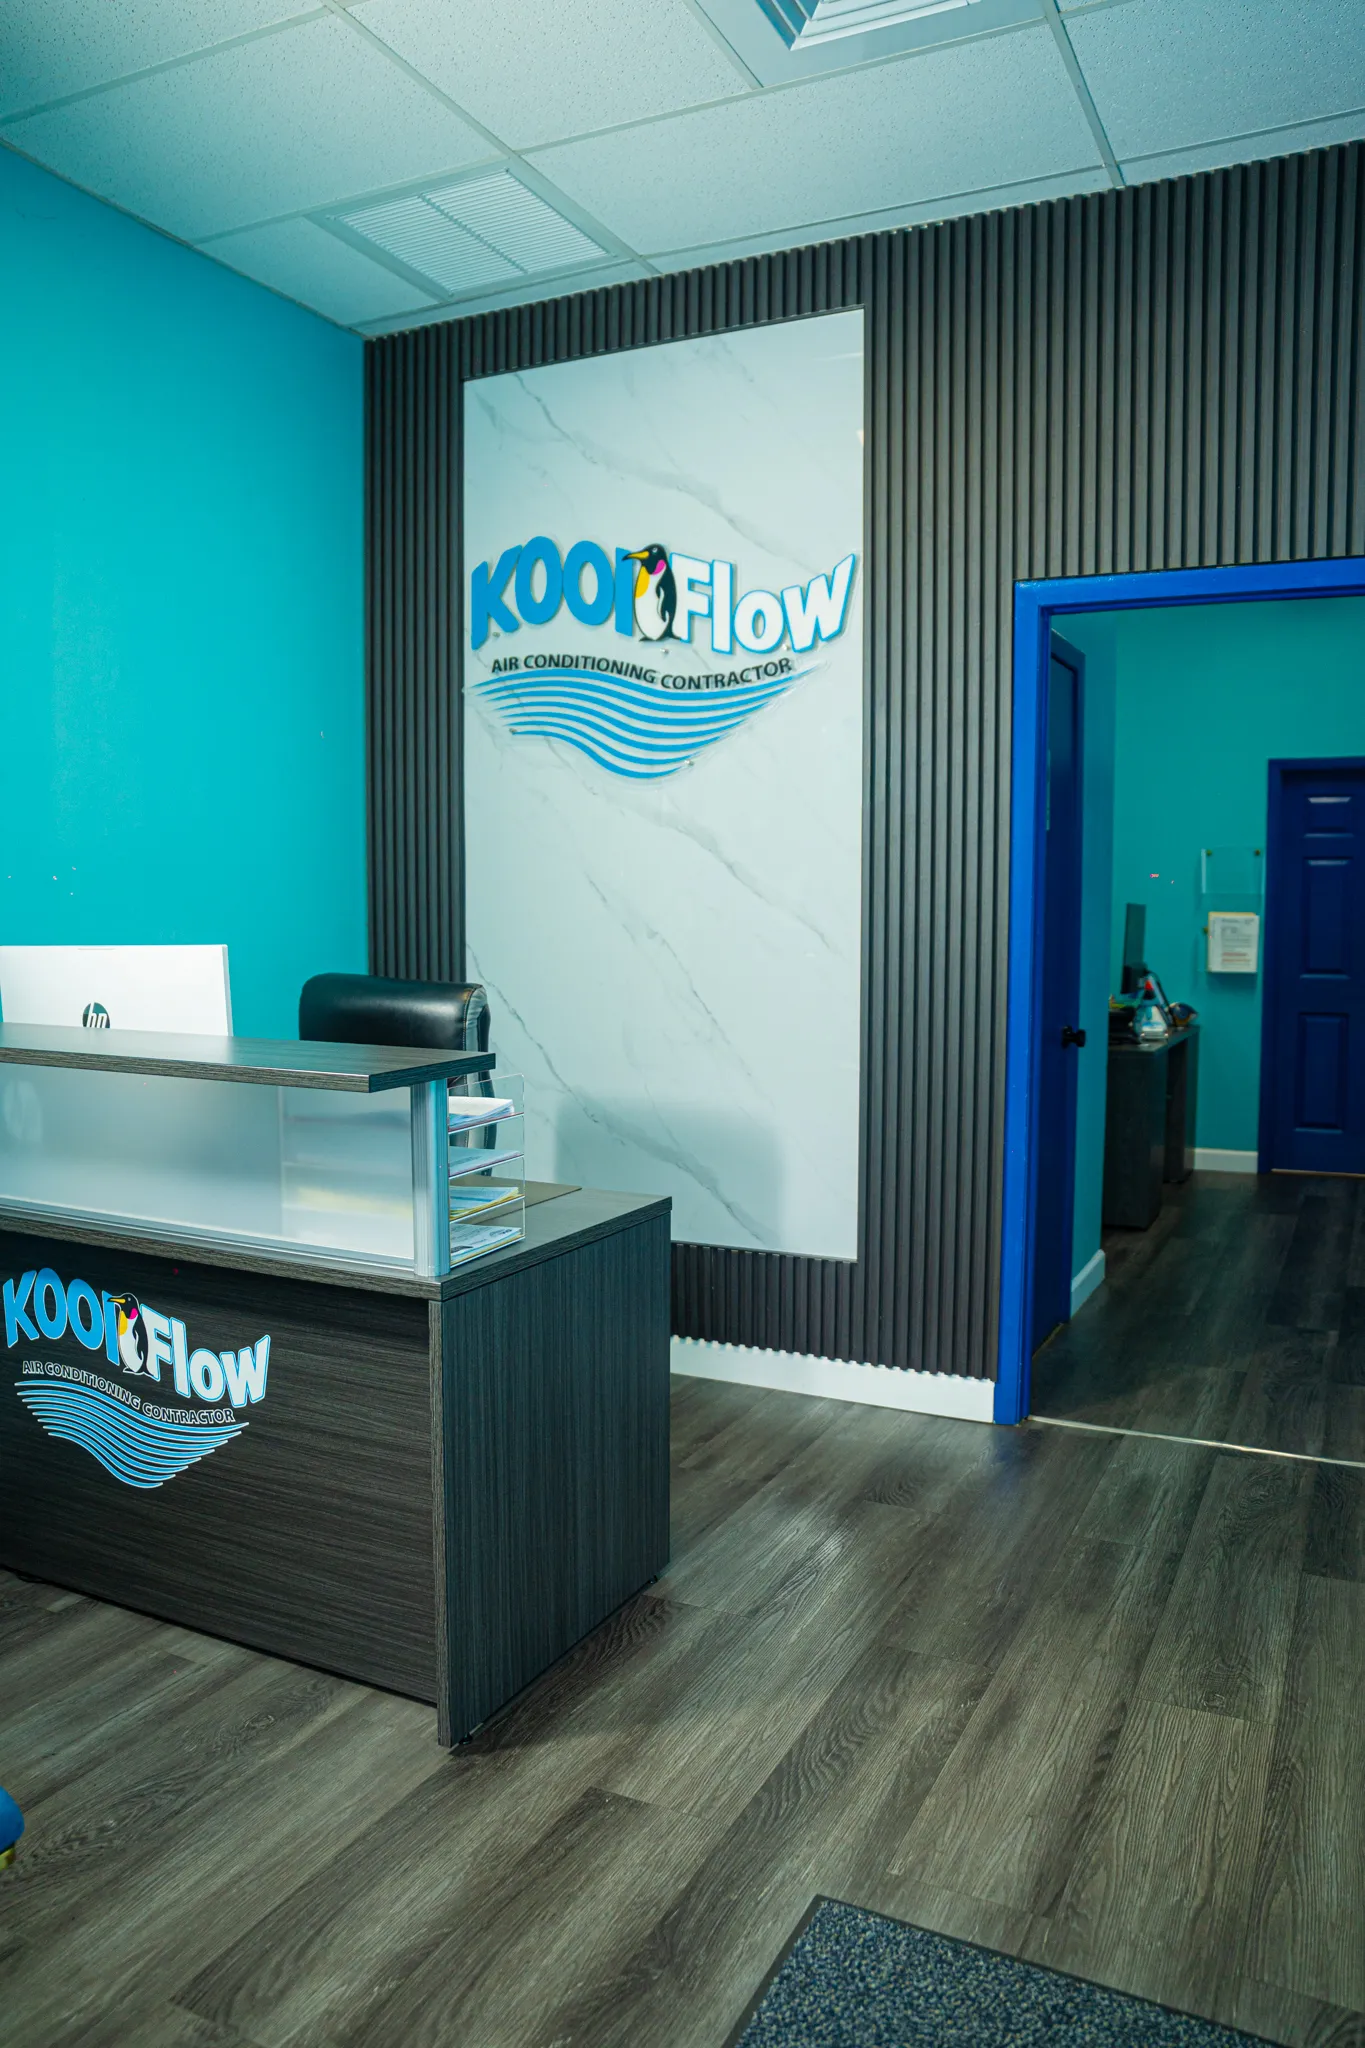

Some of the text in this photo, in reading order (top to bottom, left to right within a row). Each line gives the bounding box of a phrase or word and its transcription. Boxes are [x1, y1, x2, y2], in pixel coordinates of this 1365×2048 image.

[491, 654, 793, 690] AIR CONDITIONING CONTRACTOR
[22, 1361, 236, 1425] AIR CONDITIONING CONTRACTOR
